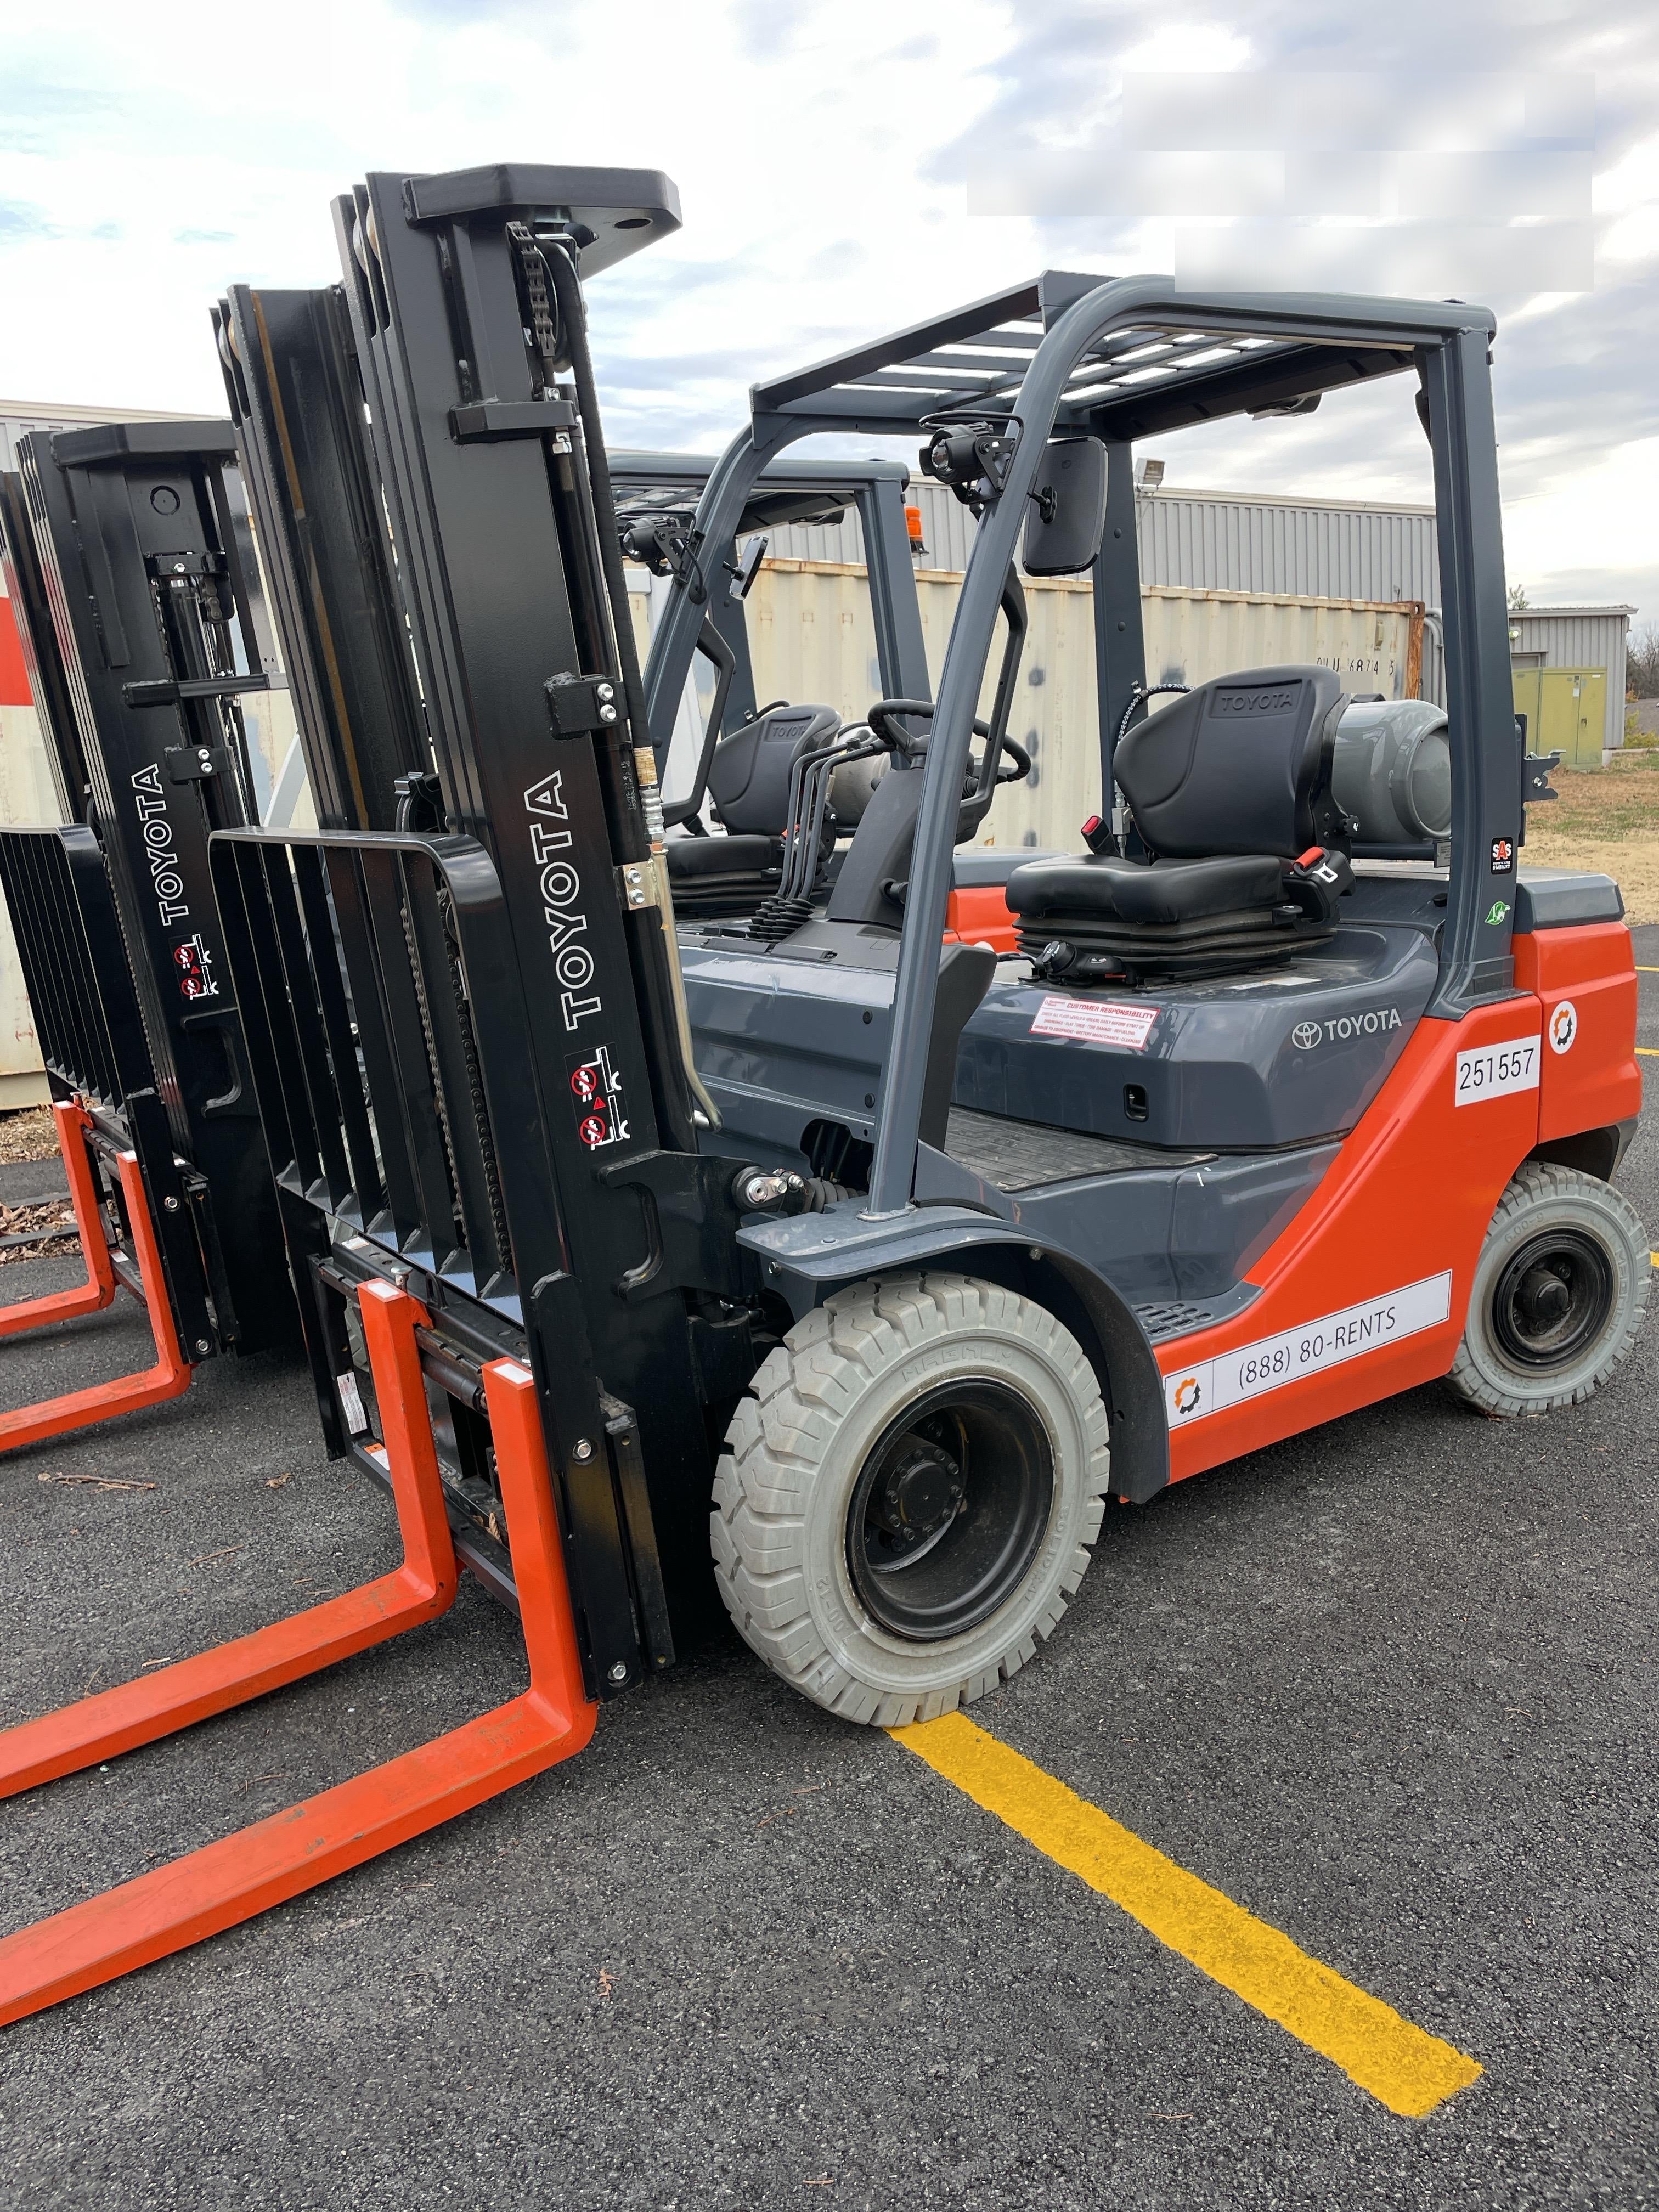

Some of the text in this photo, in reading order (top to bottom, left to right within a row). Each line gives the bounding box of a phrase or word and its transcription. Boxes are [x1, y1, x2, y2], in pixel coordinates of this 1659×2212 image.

[1390, 660, 1395, 675] 5
[1221, 691, 1293, 711] TOYOTA
[132, 763, 189, 926] TOYOTA
[1492, 840, 1511, 860] SAS
[524, 770, 602, 1031] TOYOTA
[1066, 1002, 1099, 1012] CUSTOMER
[1100, 1007, 1154, 1019] RESPONSIBILITY
[1324, 1008, 1402, 1041] TOYOTA
[1460, 1047, 1534, 1090] 251557
[1505, 1212, 1544, 1243] 6.00-9
[1239, 1306, 1396, 1390] (888) 80-RENTS
